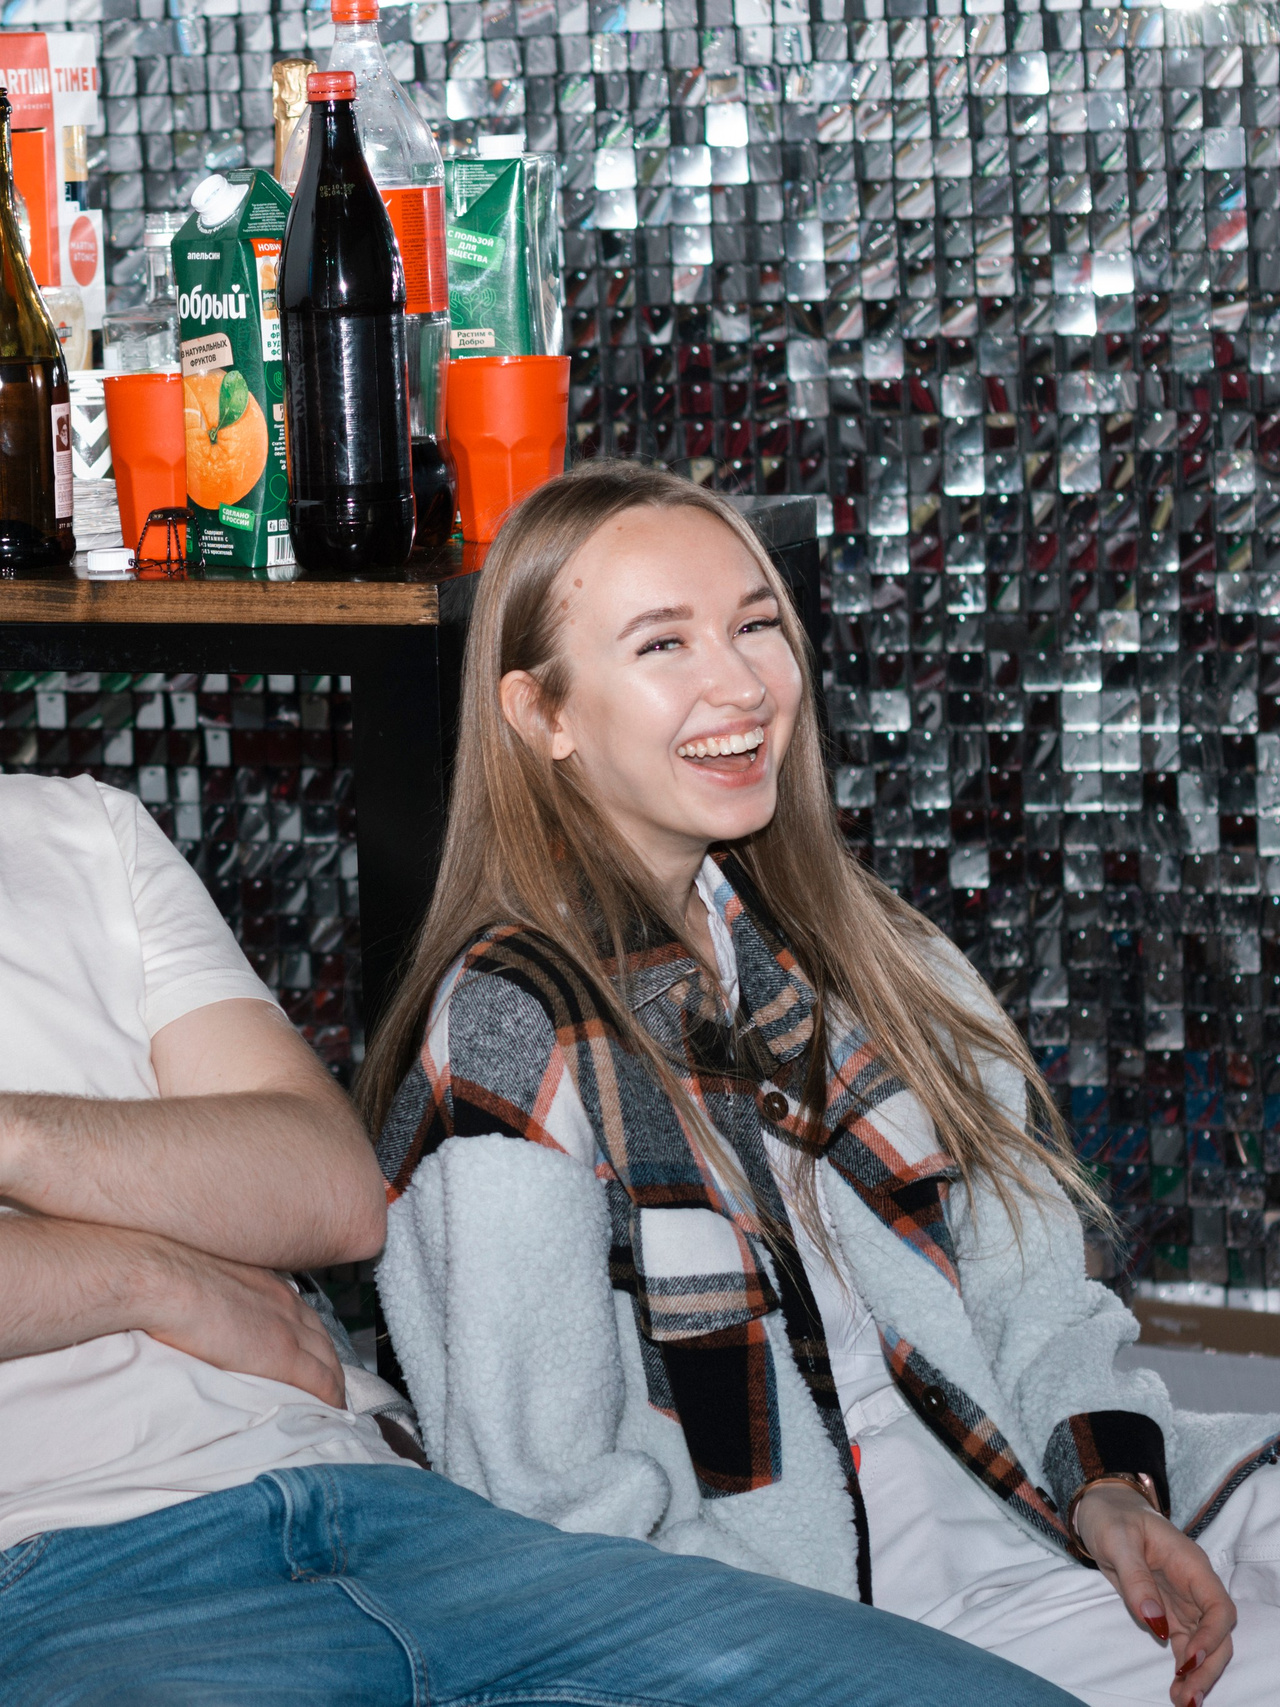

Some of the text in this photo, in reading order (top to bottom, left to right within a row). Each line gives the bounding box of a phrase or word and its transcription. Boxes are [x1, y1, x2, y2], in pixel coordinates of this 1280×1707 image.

[54, 67, 89, 92] TIME
[454, 231, 494, 247] ПОЛЬЗОЙ
[457, 241, 477, 252] ДЛЯ
[187, 252, 221, 260] апельсин
[185, 340, 228, 357] НАТУРАЛЬНЫХ
[190, 354, 217, 367] ФРУКТОВ
[222, 508, 250, 519] СДЕЛАНО
[226, 516, 250, 526] РОССИИ
